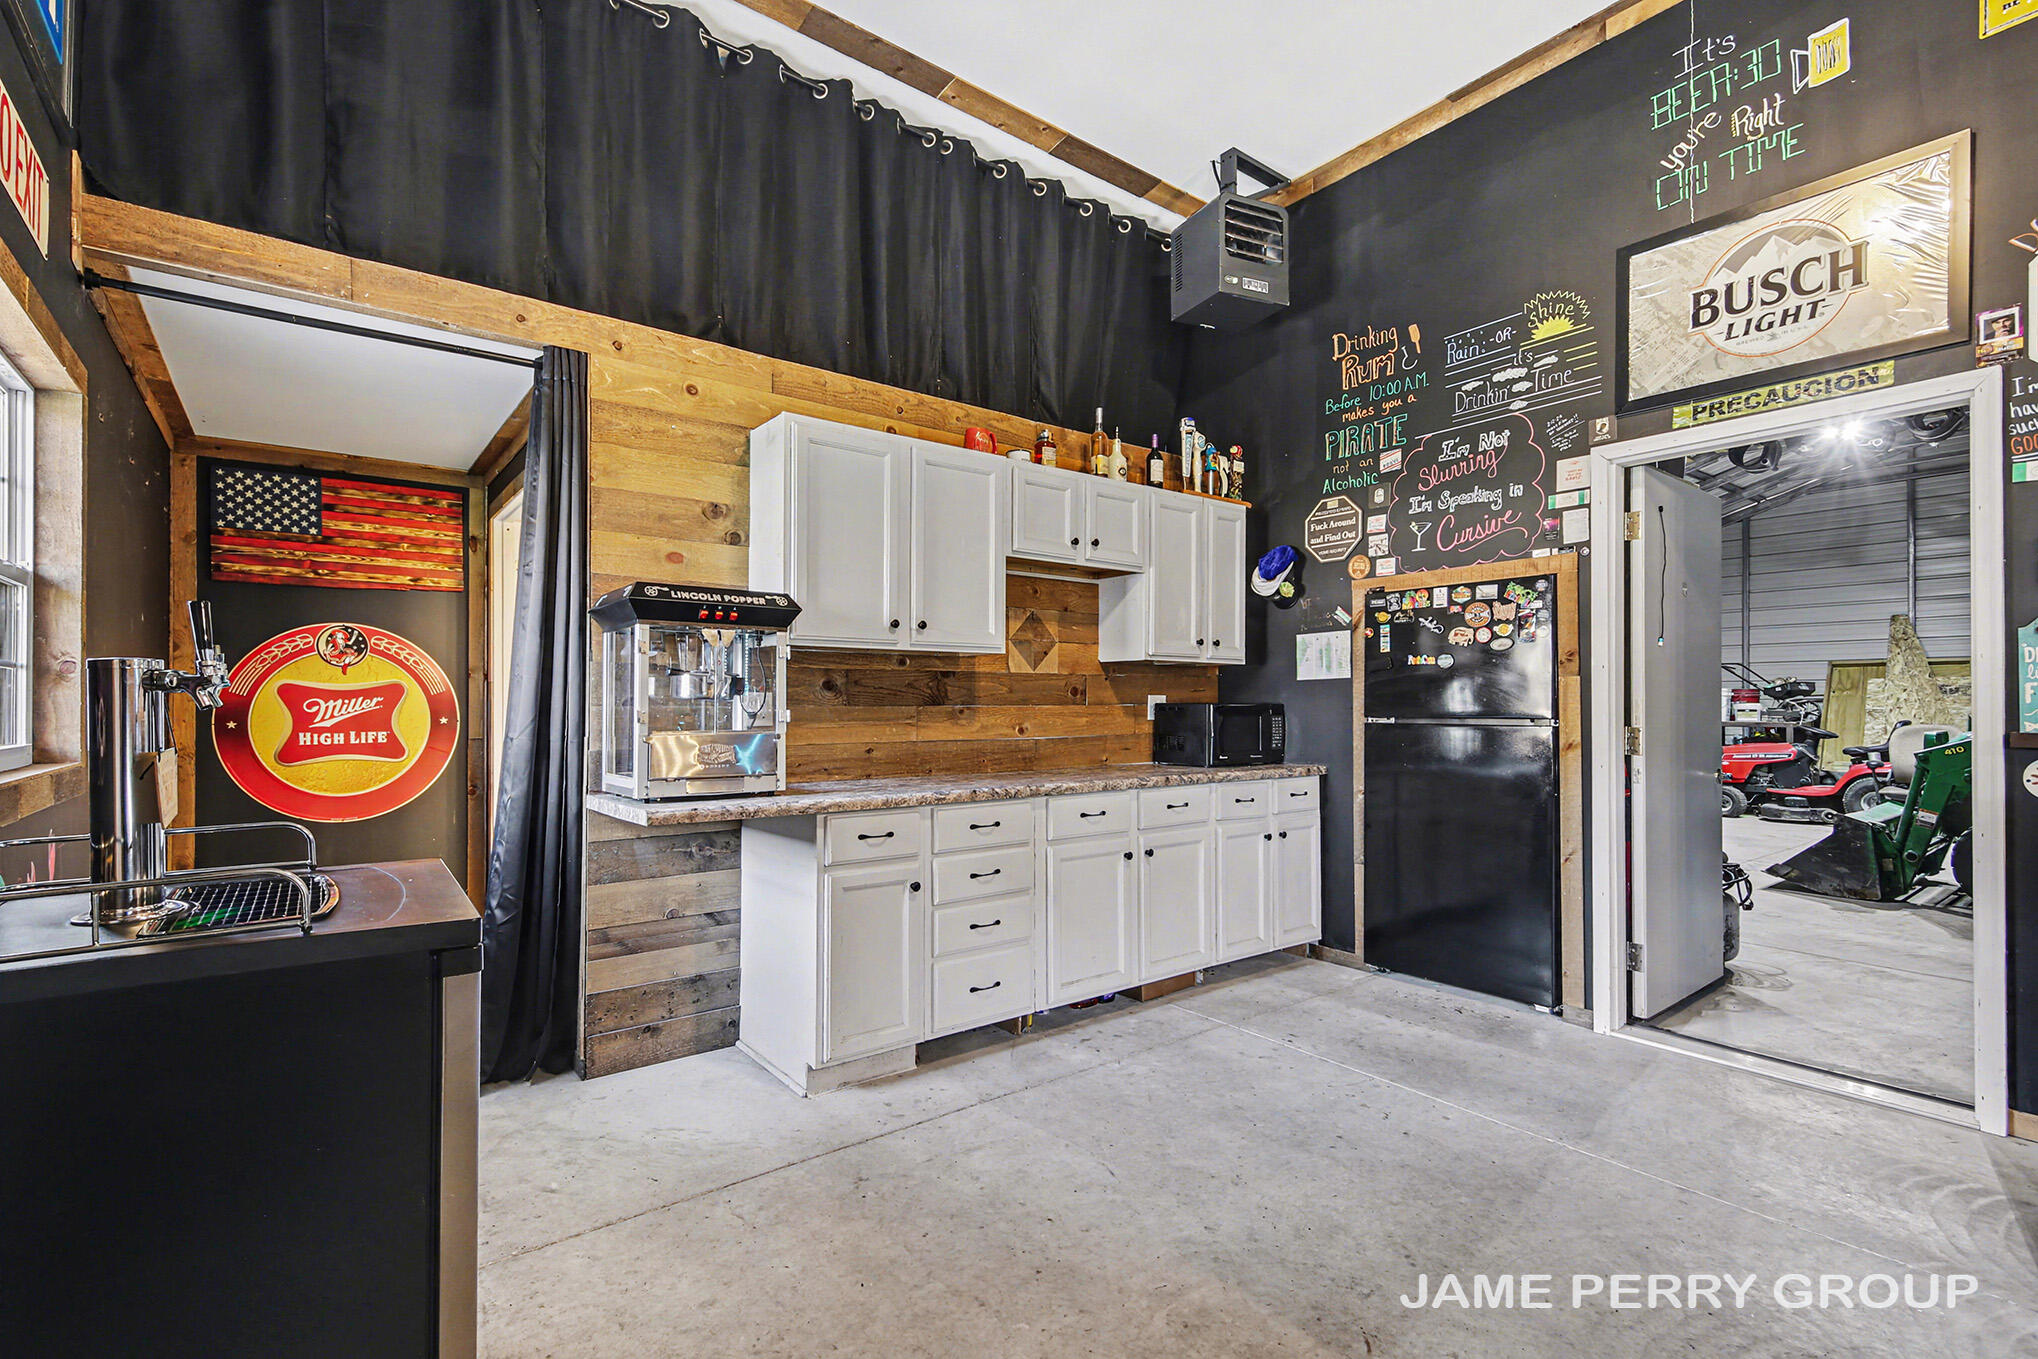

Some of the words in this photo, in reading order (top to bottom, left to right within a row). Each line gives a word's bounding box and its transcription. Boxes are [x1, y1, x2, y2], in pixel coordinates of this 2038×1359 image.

[1672, 35, 1736, 79] It's
[1731, 93, 1786, 141] Right
[0, 92, 11, 183] O
[15, 119, 44, 241] EXIT
[1656, 160, 1709, 211] ON
[1718, 123, 1806, 180] TIME
[1688, 241, 1869, 332] BUSCH
[1724, 298, 1826, 341] LIGHT
[1332, 326, 1399, 362] Drinking
[1512, 351, 1534, 366] it's
[1325, 395, 1362, 415] Before
[1369, 383, 1401, 401] 10:00
[1404, 371, 1430, 390] A.M.
[1532, 368, 1575, 393] Time
[1692, 367, 1880, 421] PRECAUCION
[1342, 405, 1375, 423] makes
[1382, 397, 1403, 415] you
[1407, 394, 1417, 404] a
[1324, 413, 1408, 461] PIRATE
[1332, 460, 1350, 474] not
[1359, 457, 1374, 467] an
[1417, 449, 1503, 491] Slurring
[1322, 472, 1380, 494] Alcoholic
[1437, 486, 1502, 511] Speaking
[1508, 483, 1524, 497] in
[1310, 522, 1328, 532] Fuck
[1329, 516, 1356, 529] Around
[1310, 535, 1324, 544] and
[1325, 532, 1341, 543] Find
[1342, 530, 1356, 540] Out
[1436, 509, 1522, 552] Cursive
[670, 590, 722, 603] LINCOLN
[724, 594, 766, 606] POPPER
[302, 696, 385, 729] Miller
[298, 731, 345, 746] HIGH
[349, 731, 388, 745] LIFE
[1944, 746, 1965, 755] 410
